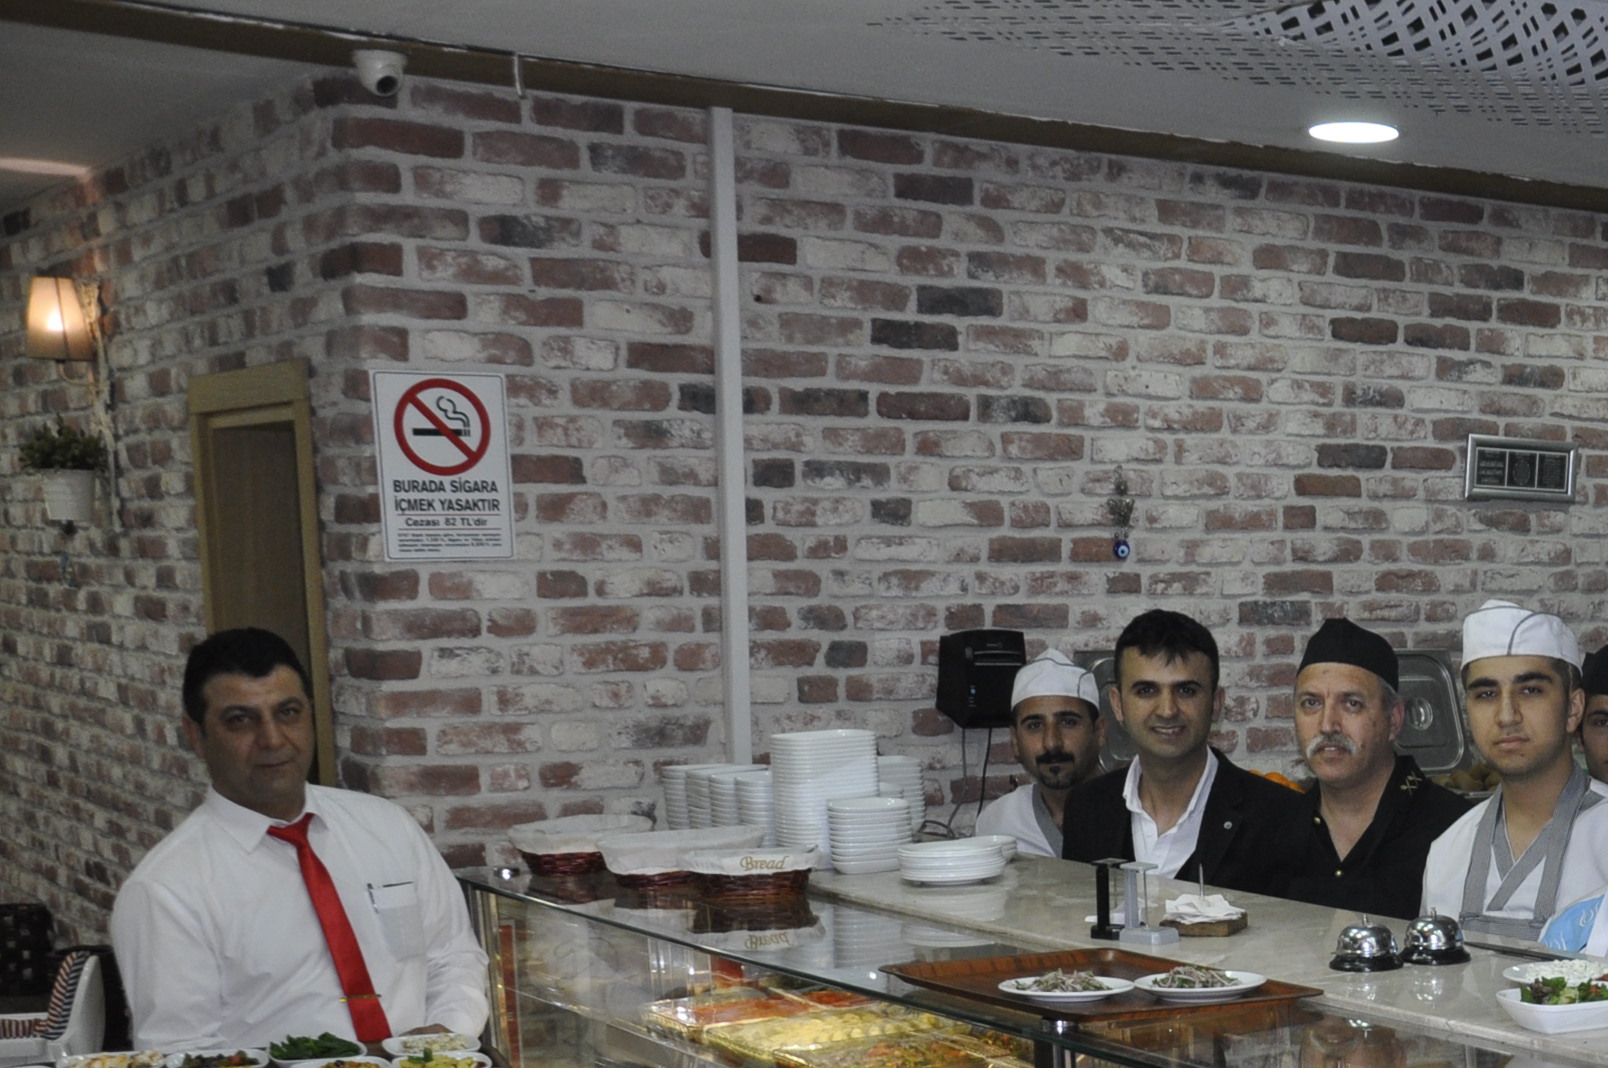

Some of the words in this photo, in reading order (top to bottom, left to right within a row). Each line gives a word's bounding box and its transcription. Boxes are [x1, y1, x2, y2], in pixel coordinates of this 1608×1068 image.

[393, 480, 446, 493] BURADA
[450, 477, 499, 493] SİGARA
[394, 495, 436, 515] İÇMEK
[439, 499, 501, 512] YASAKTIR
[405, 517, 440, 527] Cezası
[444, 517, 457, 527] 82
[740, 856, 789, 871] Bread
